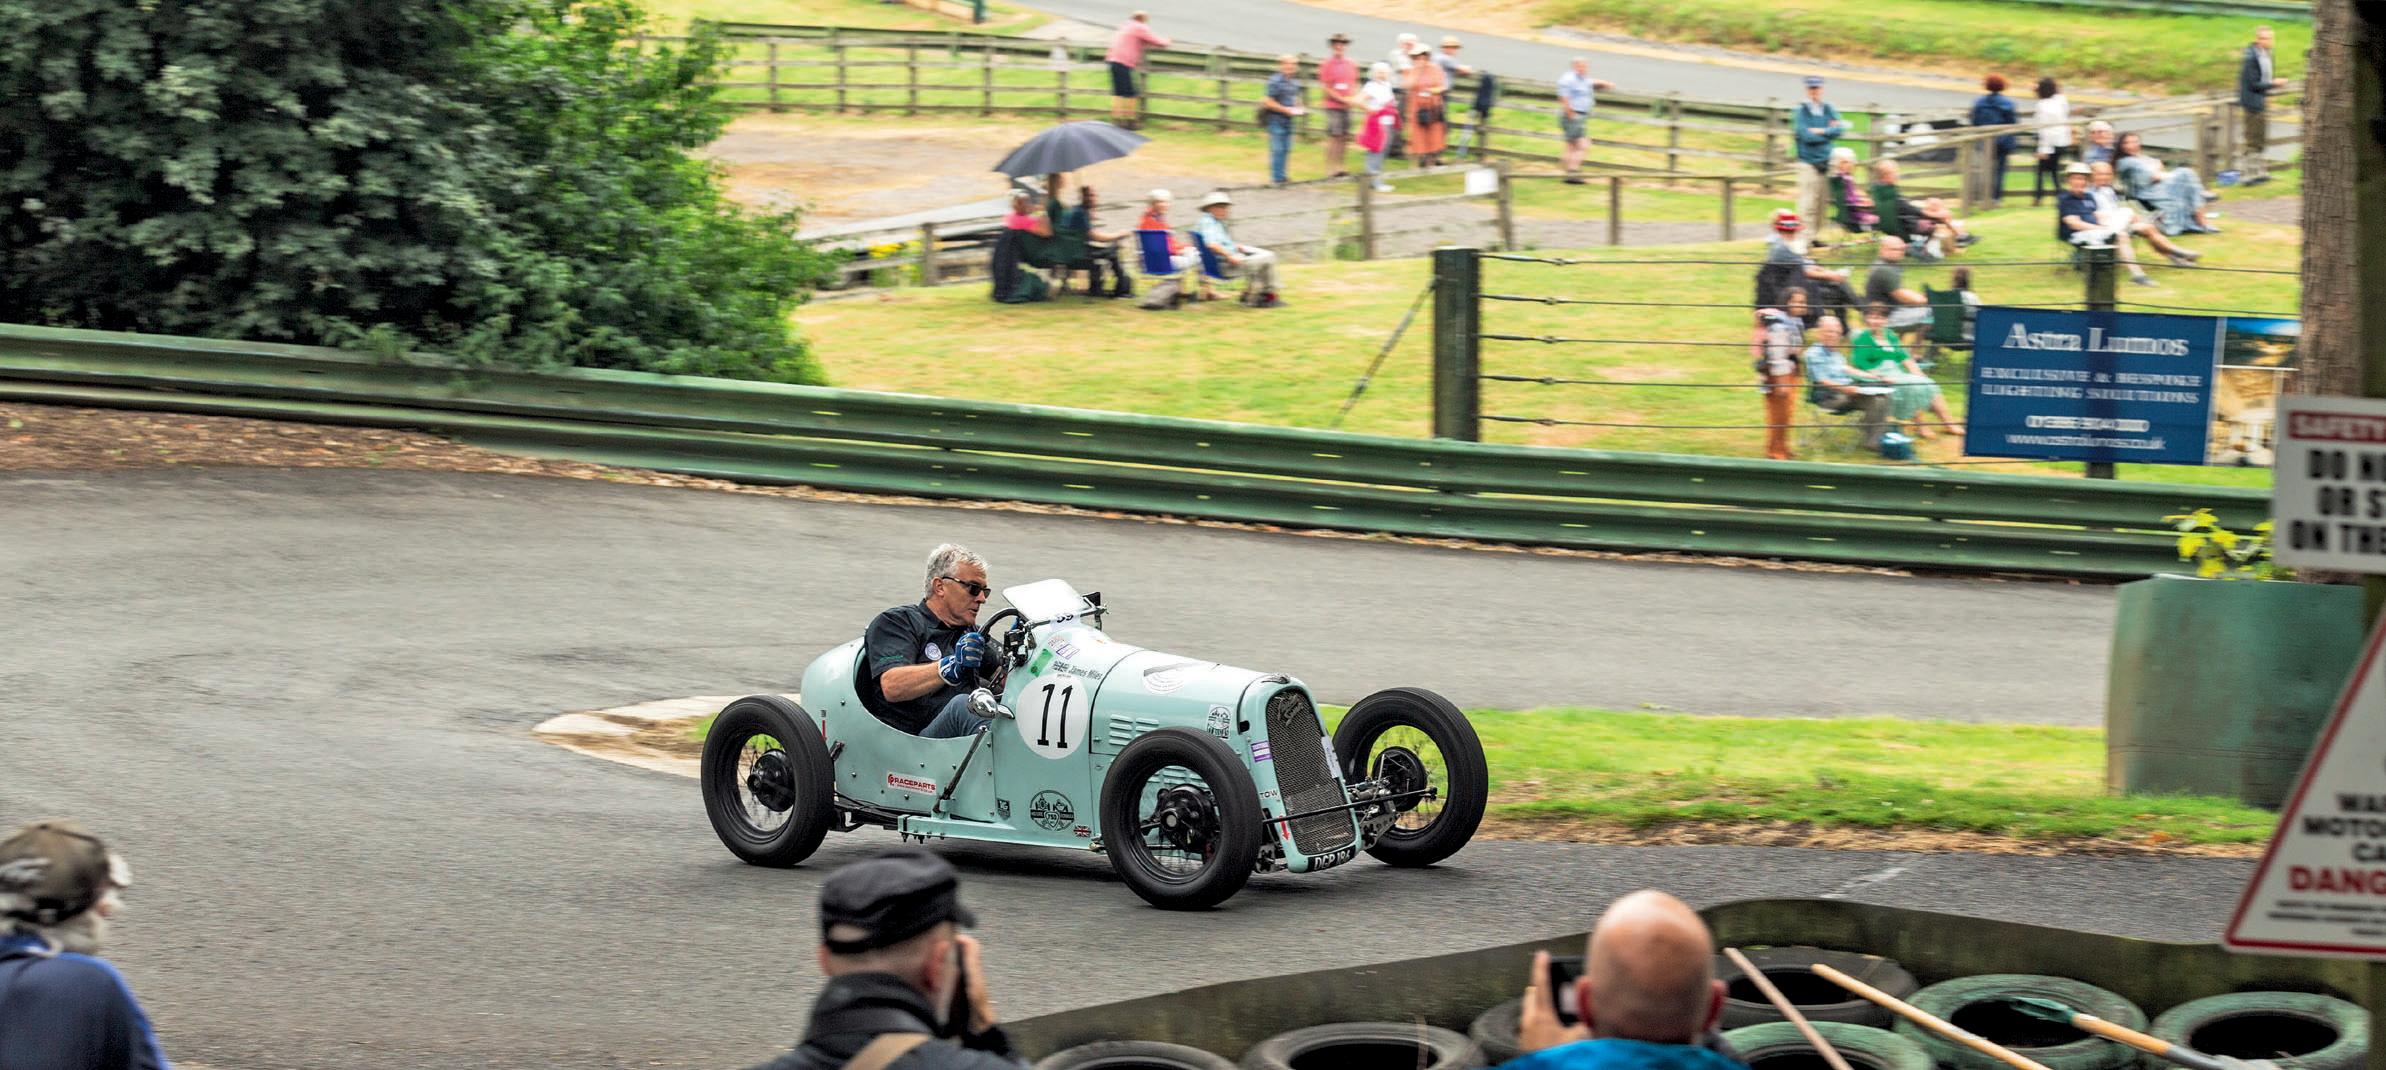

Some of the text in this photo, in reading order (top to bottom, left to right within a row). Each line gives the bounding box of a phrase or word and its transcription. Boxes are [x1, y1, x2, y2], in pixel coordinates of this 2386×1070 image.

[2002, 322, 2190, 356] Astra Lumos
[1037, 683, 1073, 748] 11
[894, 777, 936, 791] RACEPARTS
[1260, 789, 1278, 799] TOW
